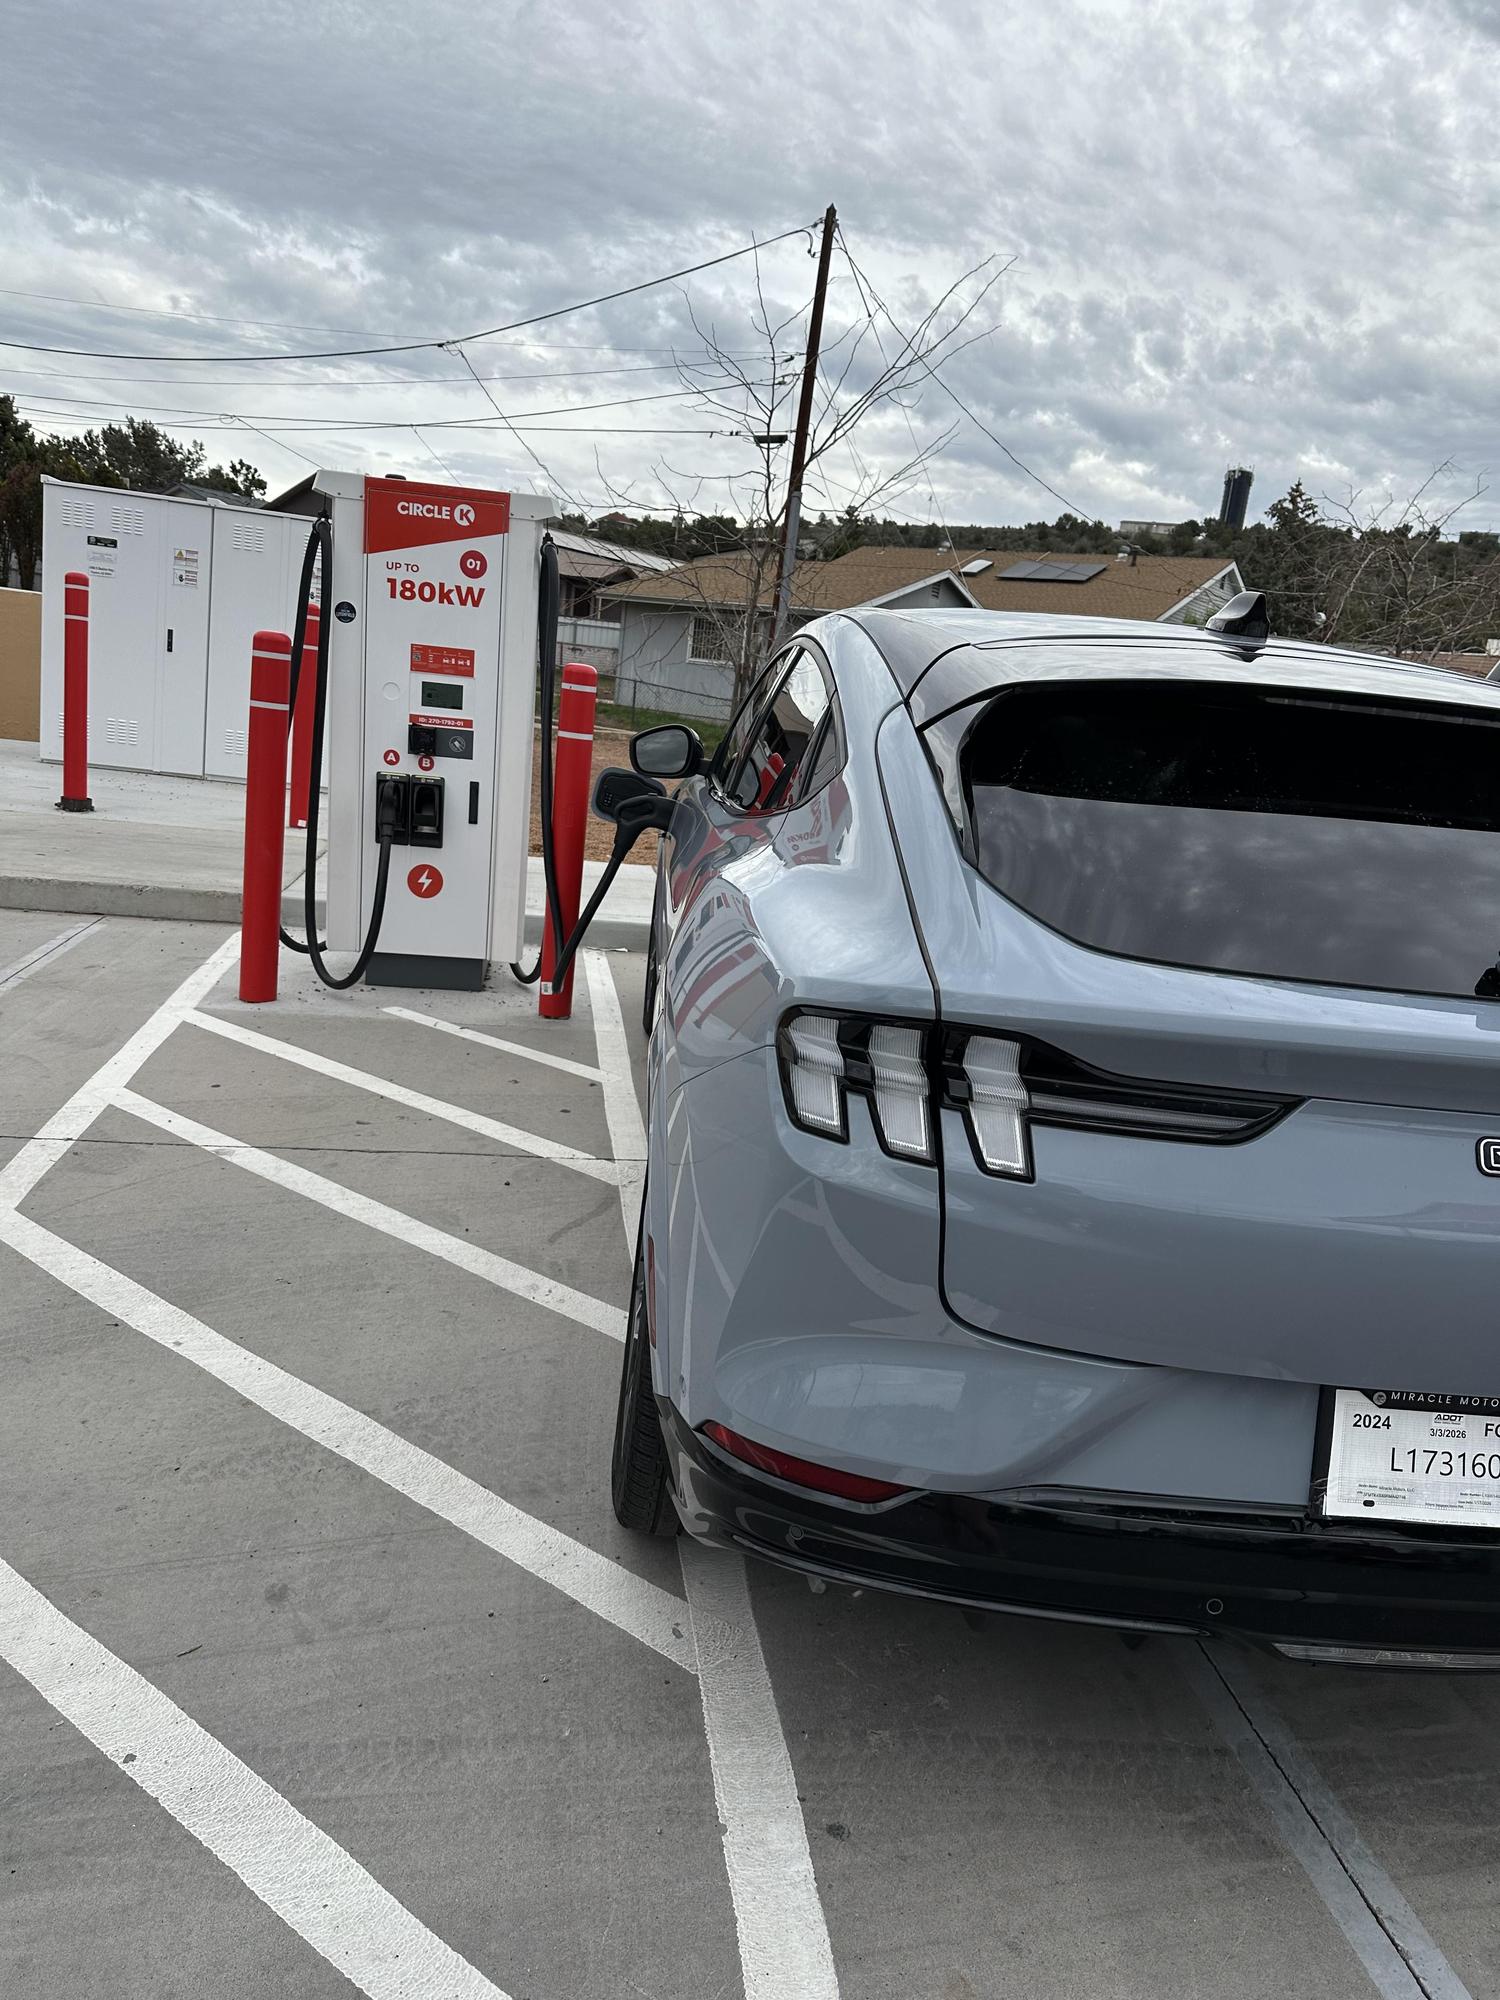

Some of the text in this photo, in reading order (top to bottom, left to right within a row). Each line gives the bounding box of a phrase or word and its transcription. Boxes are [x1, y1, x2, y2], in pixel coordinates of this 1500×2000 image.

[397, 502, 475, 526] CIRCLE K
[386, 561, 420, 573] UP TO
[466, 558, 481, 571] 01
[387, 578, 485, 608] 180kW
[387, 753, 431, 767] A B
[1391, 1391, 1453, 1404] MIRACLE
[1353, 1414, 1391, 1429] 2024
[1434, 1414, 1464, 1422] ADOT
[1430, 1429, 1466, 1438] 3/3/2026
